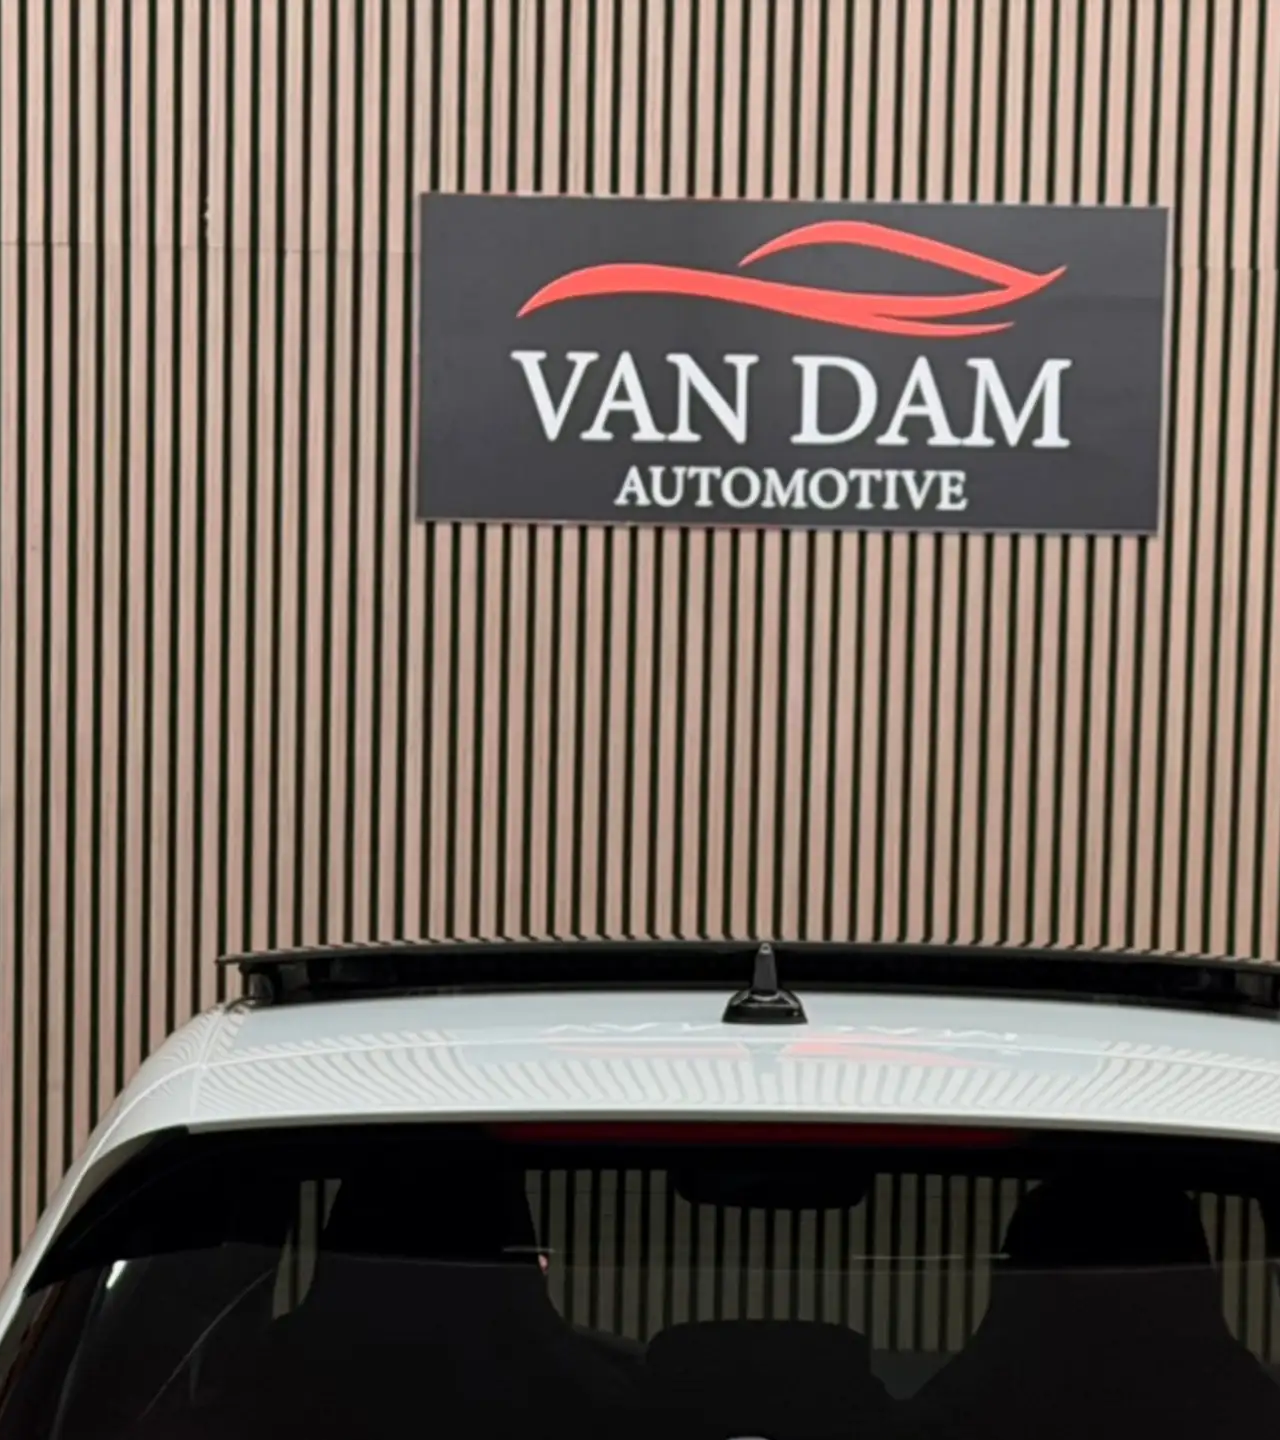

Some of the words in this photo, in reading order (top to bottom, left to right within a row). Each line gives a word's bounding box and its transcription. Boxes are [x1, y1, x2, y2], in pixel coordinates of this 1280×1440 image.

[511, 350, 759, 443] VAN
[791, 355, 1072, 448] DAM
[614, 466, 969, 511] AUTOMOTIVE
